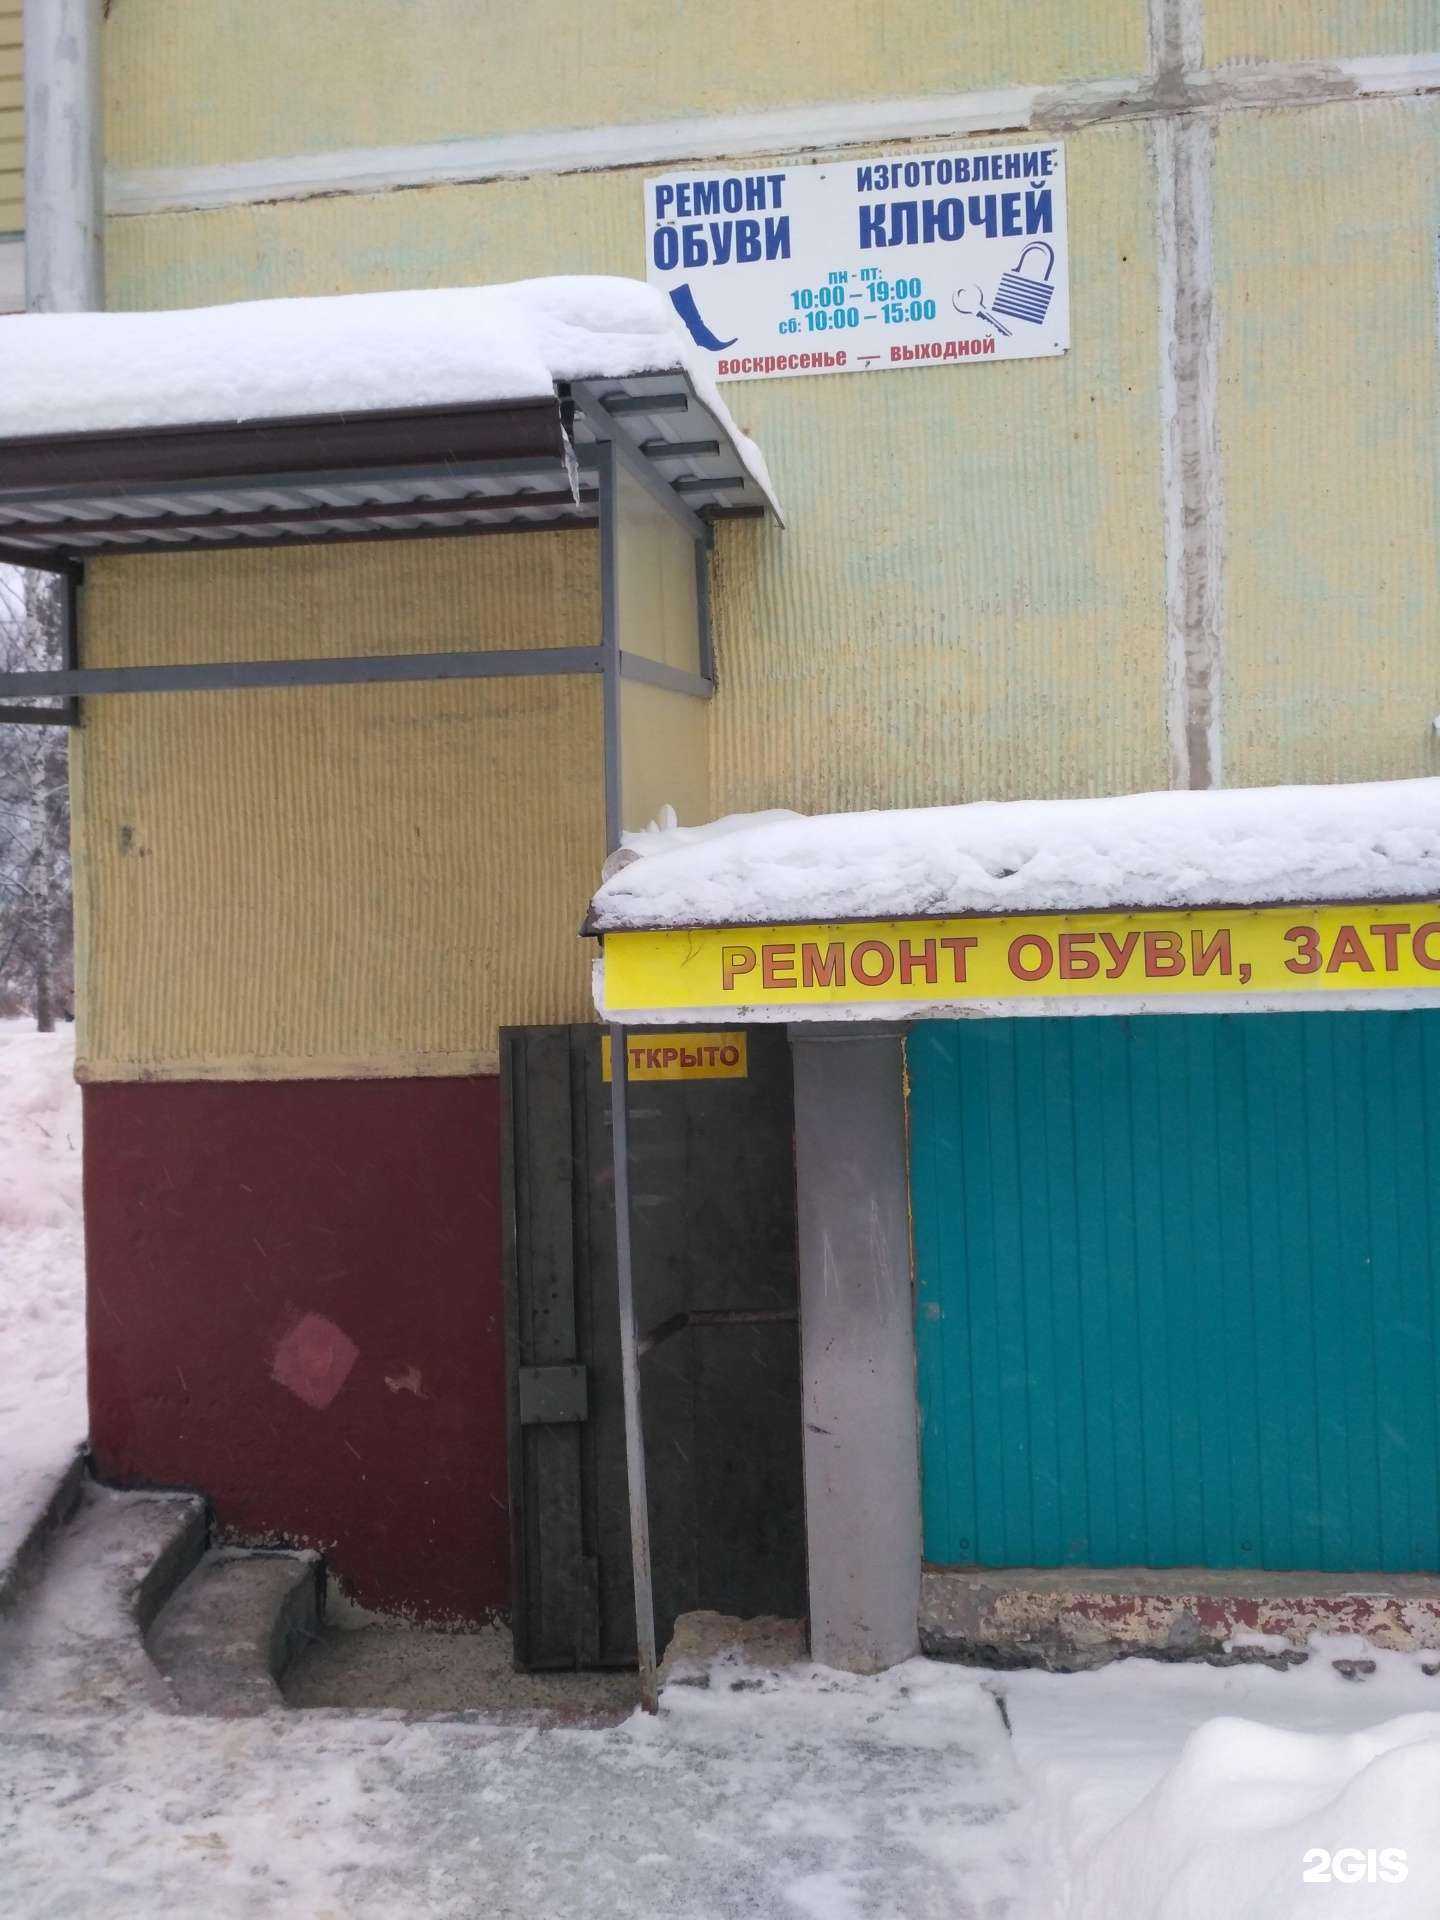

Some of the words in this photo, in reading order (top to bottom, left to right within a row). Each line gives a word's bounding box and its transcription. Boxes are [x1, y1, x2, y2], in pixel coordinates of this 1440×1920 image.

[857, 150, 1053, 192] ИЗГОТОВЛЕНИЕ
[655, 174, 786, 219] РЕМОНТ
[859, 181, 1053, 249] КЛЮЧЕЙ
[653, 215, 791, 271] ОБУВИ
[791, 285, 845, 310] 10:00
[866, 278, 921, 302] 19:00
[828, 271, 848, 284] пн
[860, 267, 882, 281] пт:
[778, 317, 801, 334] сб:
[805, 307, 859, 331] 10:00
[881, 299, 936, 324] 15:00
[718, 350, 847, 376] воскресенье
[890, 334, 996, 362] выходной
[721, 936, 979, 991] РЕМОНТ
[1007, 928, 1253, 986] ОБУВИ,
[610, 1045, 740, 1069] ТКРЫТО
